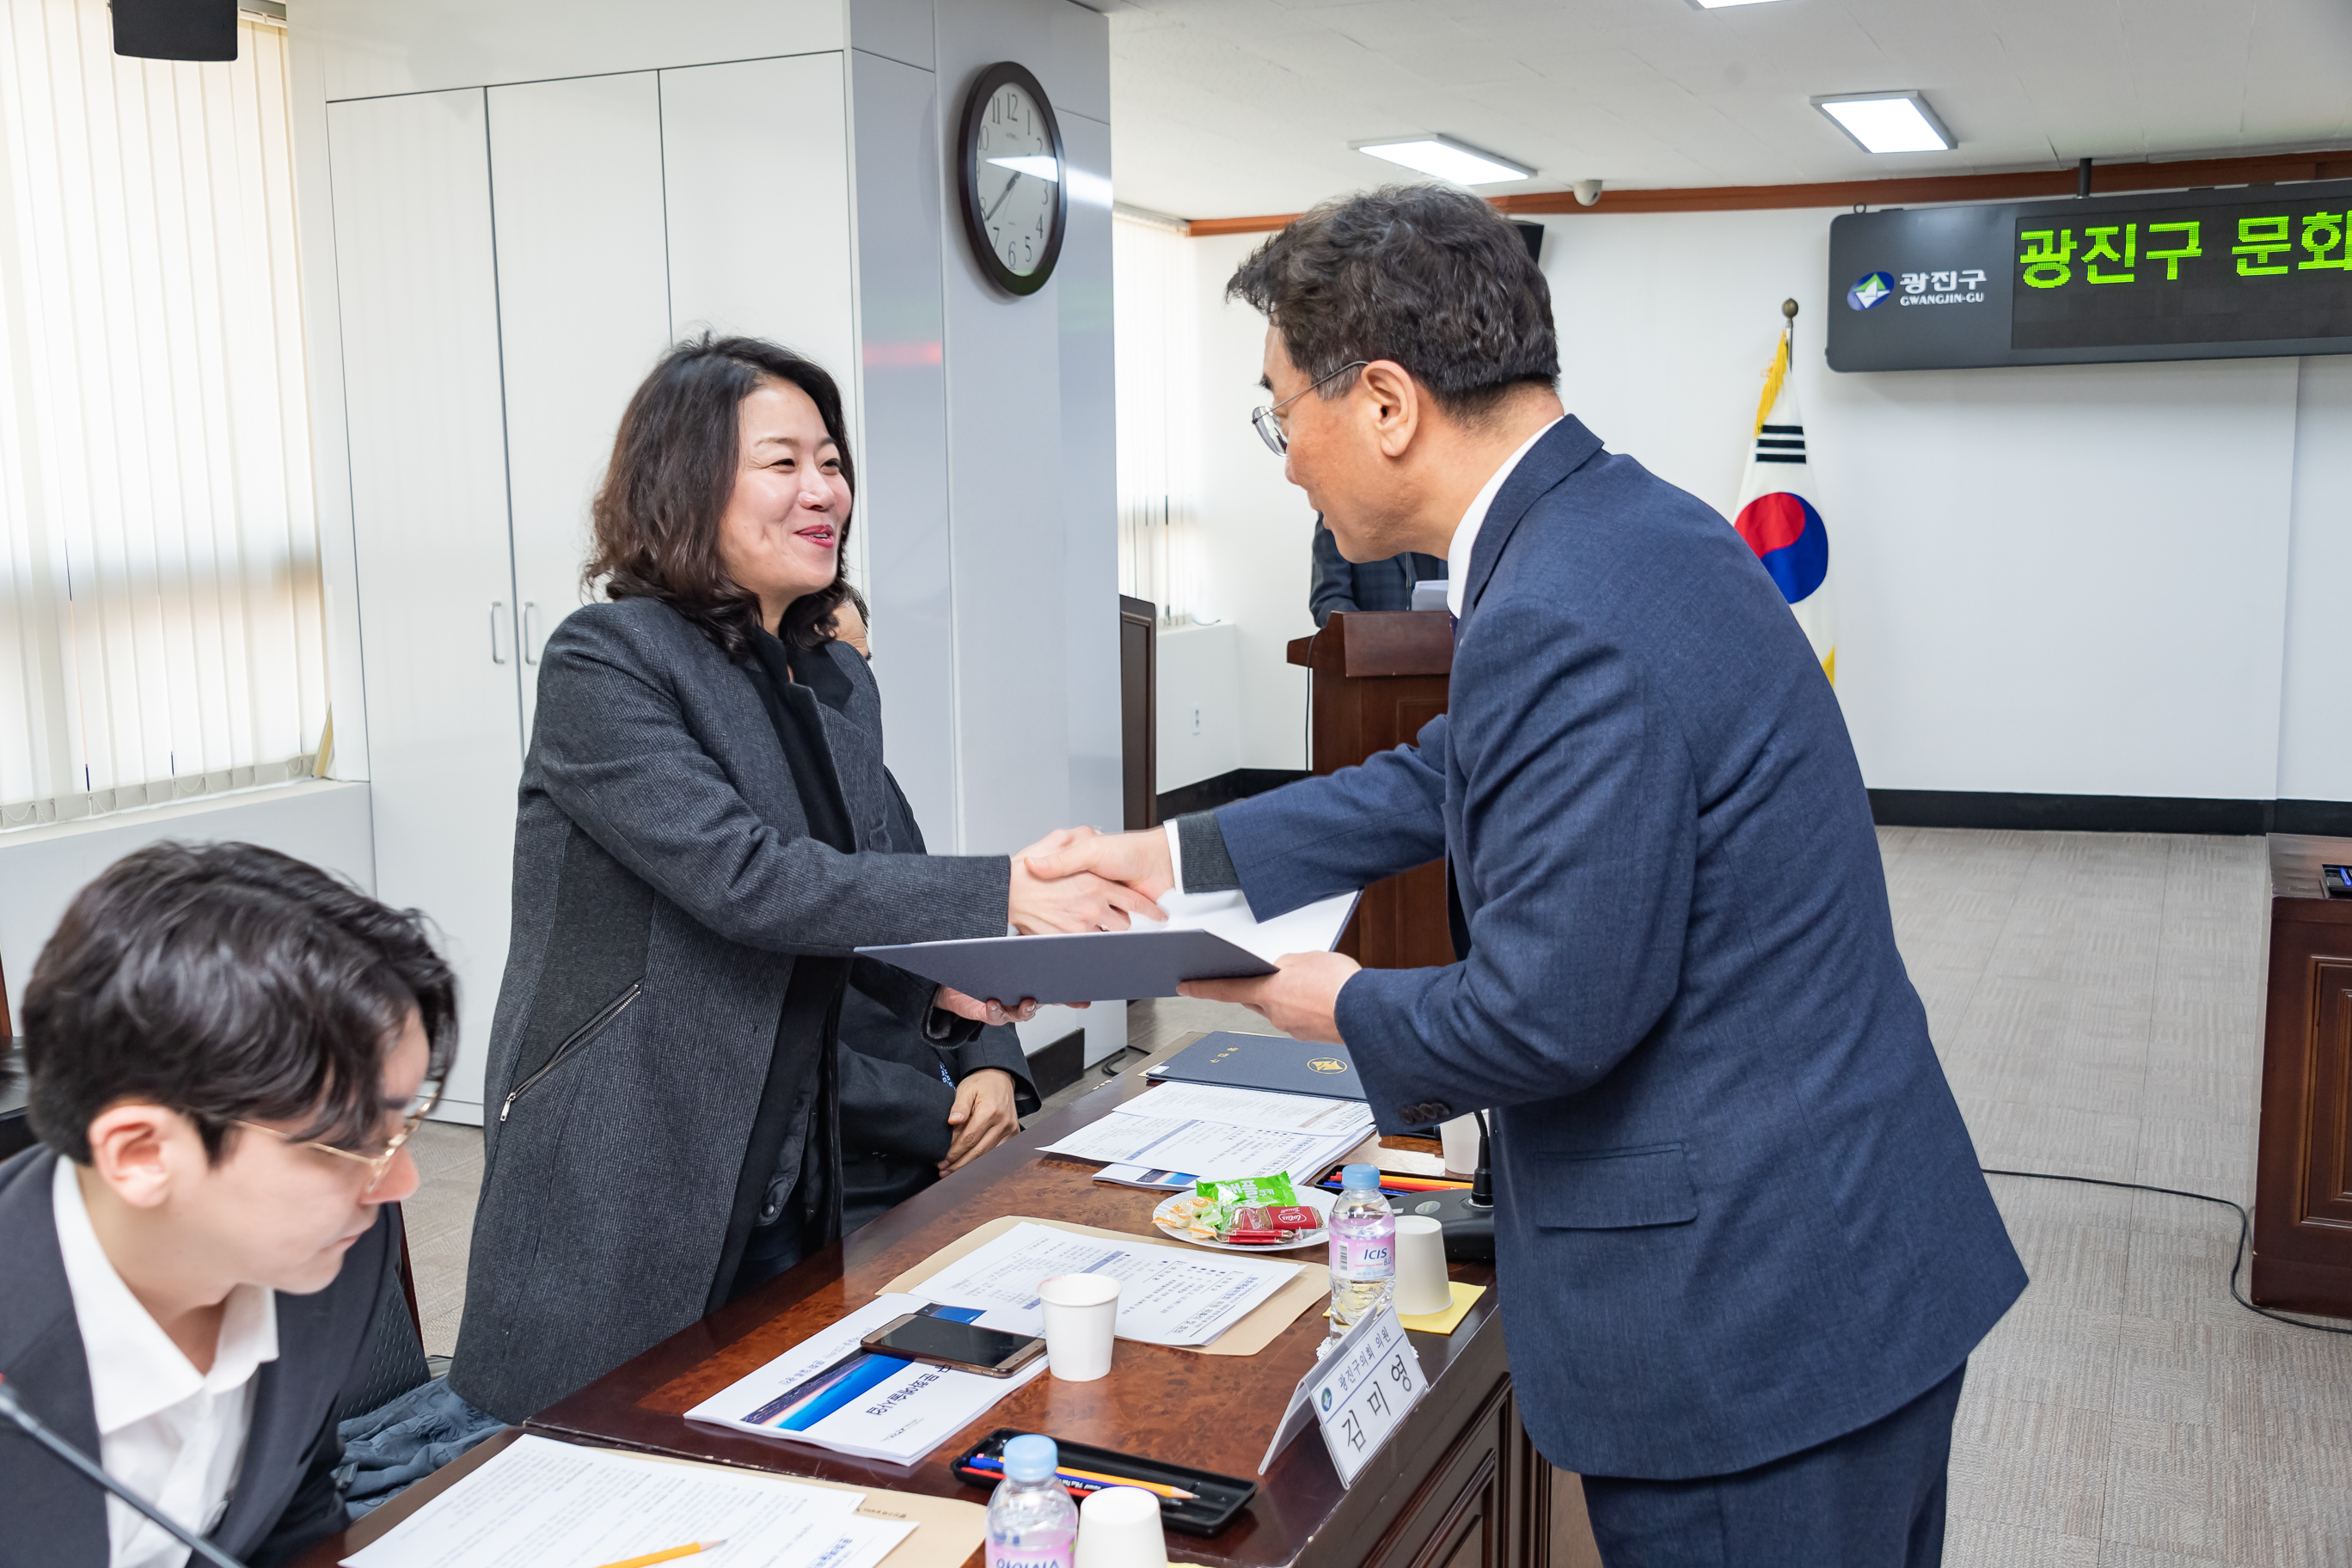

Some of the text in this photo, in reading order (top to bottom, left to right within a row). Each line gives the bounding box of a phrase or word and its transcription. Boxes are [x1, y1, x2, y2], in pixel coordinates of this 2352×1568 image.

[991, 96, 1001, 125] 11
[1007, 92, 1018, 122] 12
[1026, 109, 1031, 135] 1
[1041, 179, 1049, 205] 3
[993, 227, 1000, 251] 7
[1035, 214, 1044, 239] 4
[1008, 241, 1016, 268] 6
[1024, 236, 1032, 263] 5
[2020, 223, 2202, 289] 광진구
[1900, 269, 1988, 294] 광진구
[1900, 292, 1984, 306] GWANGJIN-GU
[1363, 1247, 1387, 1259] ICIS
[1383, 1257, 1392, 1266] 8.0
[1338, 1326, 1392, 1392] 광진구의회 의원
